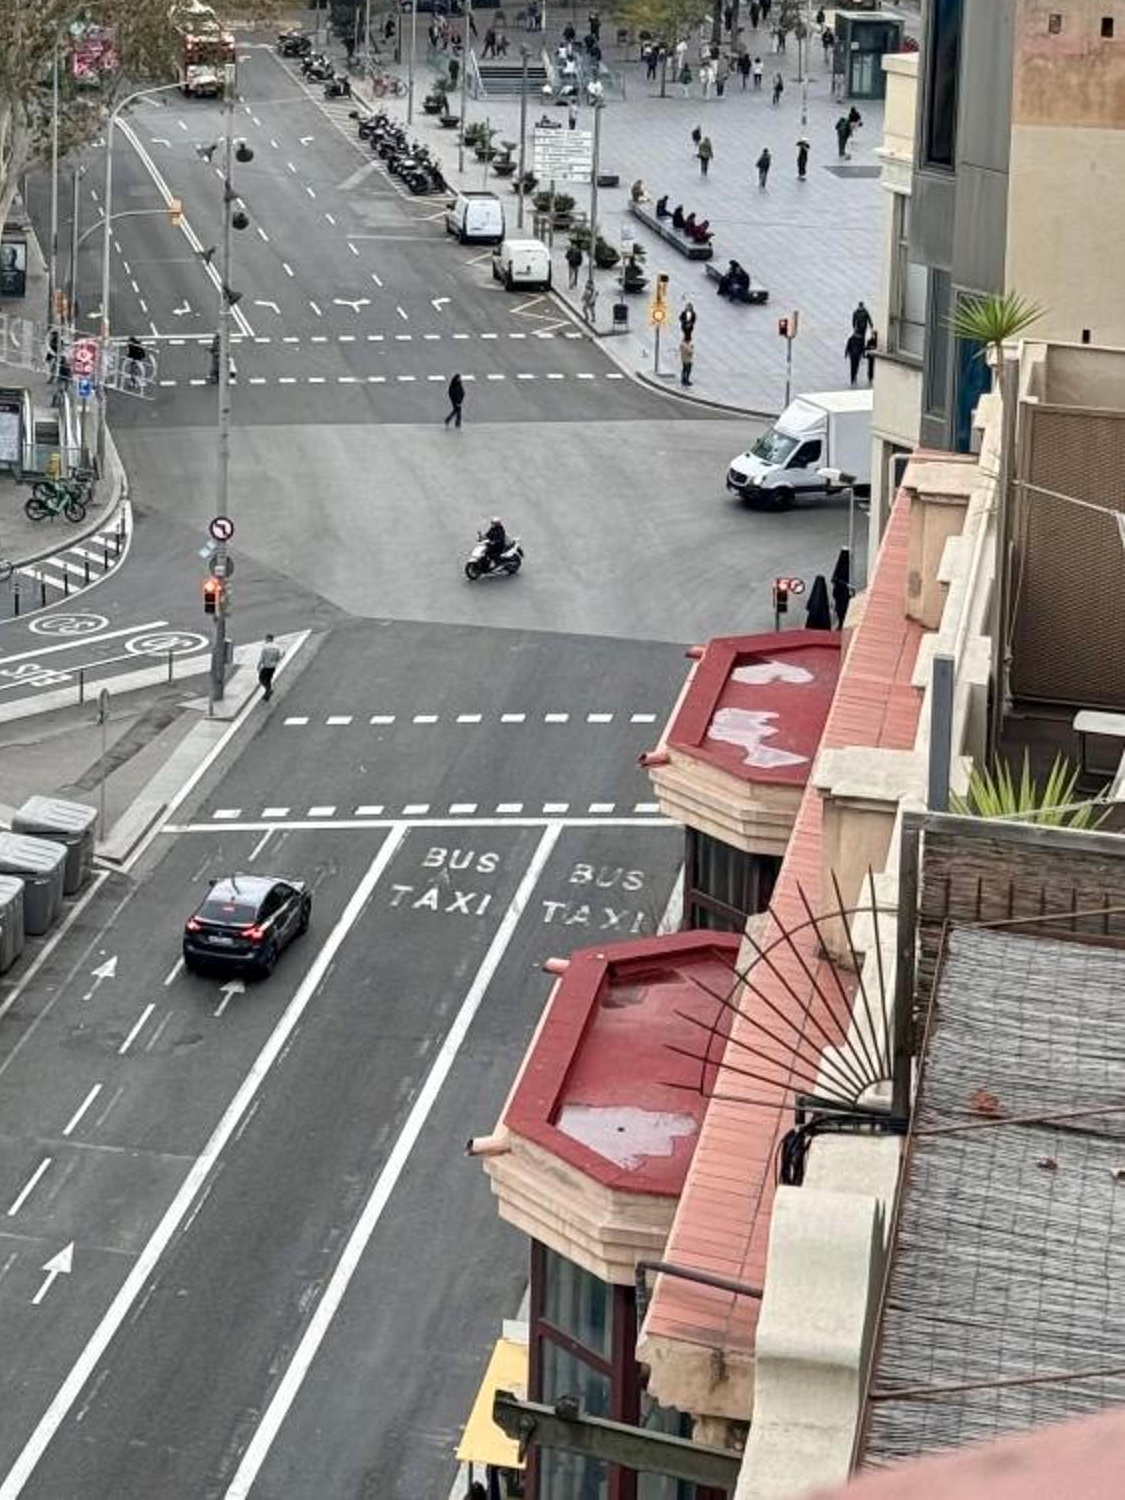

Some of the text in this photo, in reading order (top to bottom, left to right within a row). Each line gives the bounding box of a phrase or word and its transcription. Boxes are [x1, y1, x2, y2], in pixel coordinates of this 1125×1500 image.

[421, 847, 500, 873] BUS
[568, 863, 644, 891] BUS
[389, 884, 492, 915] TAXI
[541, 900, 645, 933] TAXI
